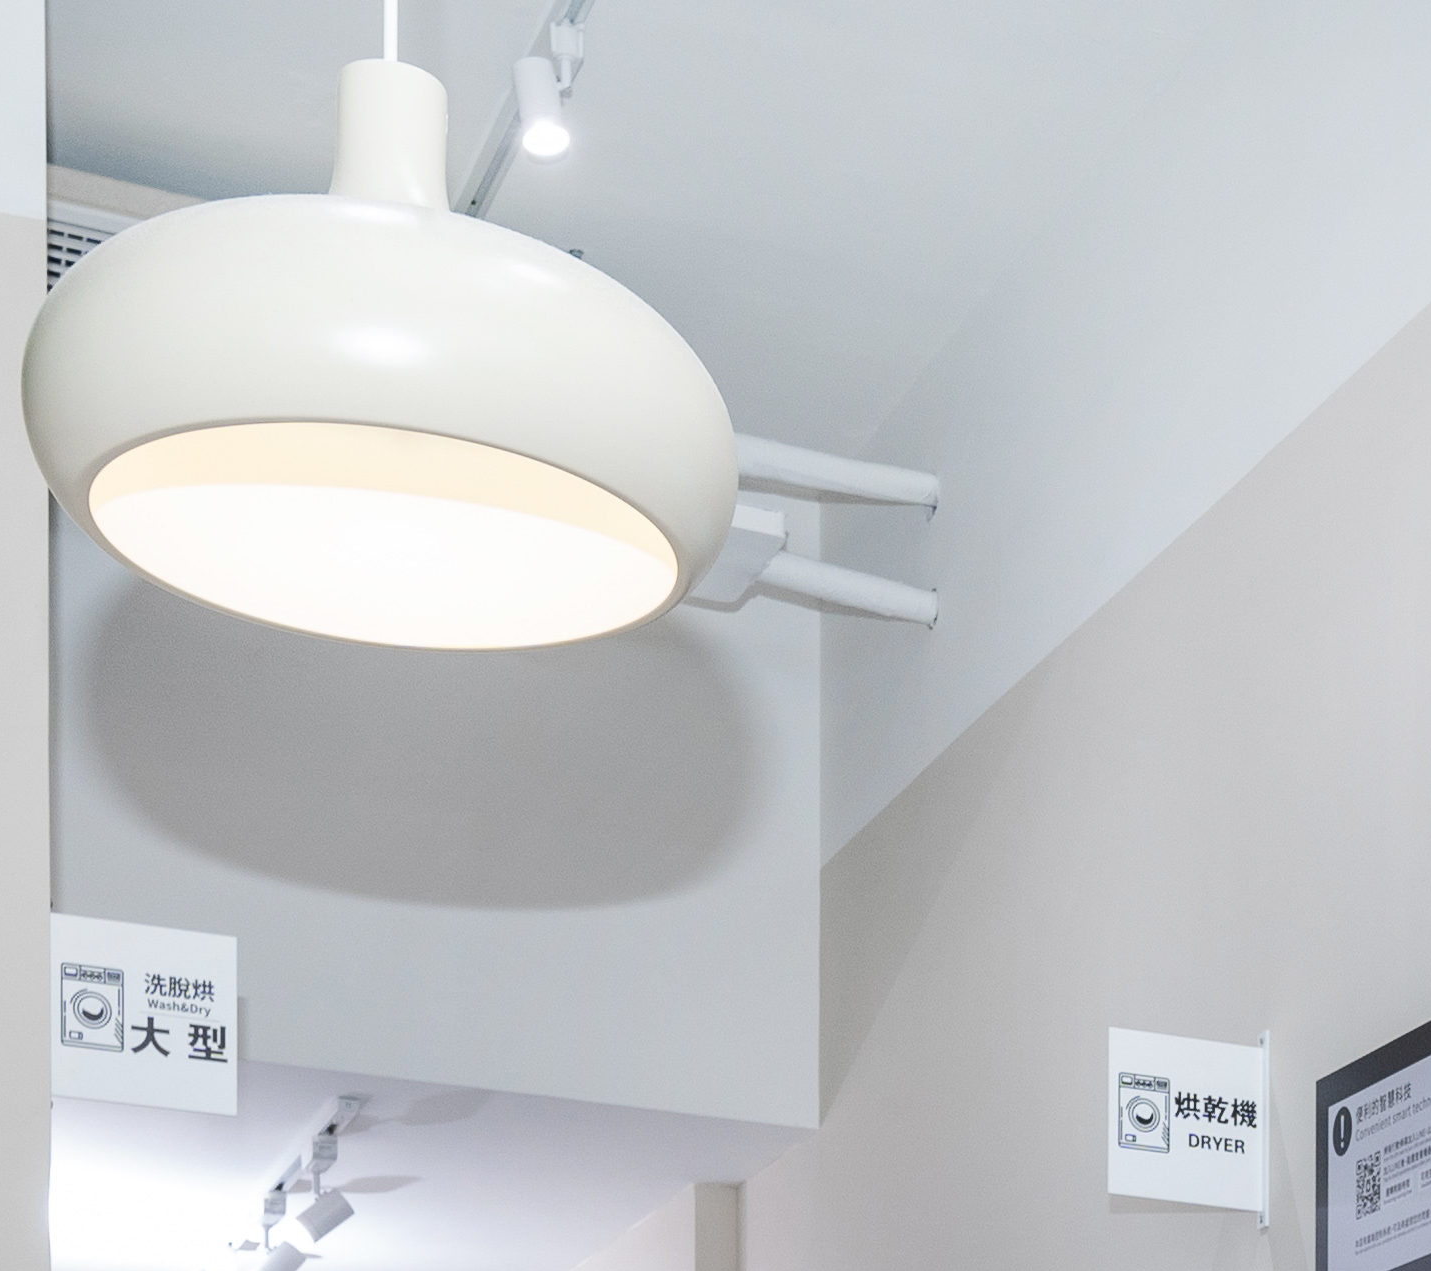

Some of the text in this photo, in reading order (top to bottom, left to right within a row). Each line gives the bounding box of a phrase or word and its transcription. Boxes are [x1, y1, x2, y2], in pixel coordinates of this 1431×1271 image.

[145, 973, 215, 1002] 洗脫烘
[147, 998, 211, 1017] Wash&Dry
[1174, 1091, 1258, 1129] 烘乾機
[1355, 1114, 1391, 1142] Convenient
[1393, 1104, 1411, 1124] smart
[1188, 1133, 1245, 1154] DRYER
